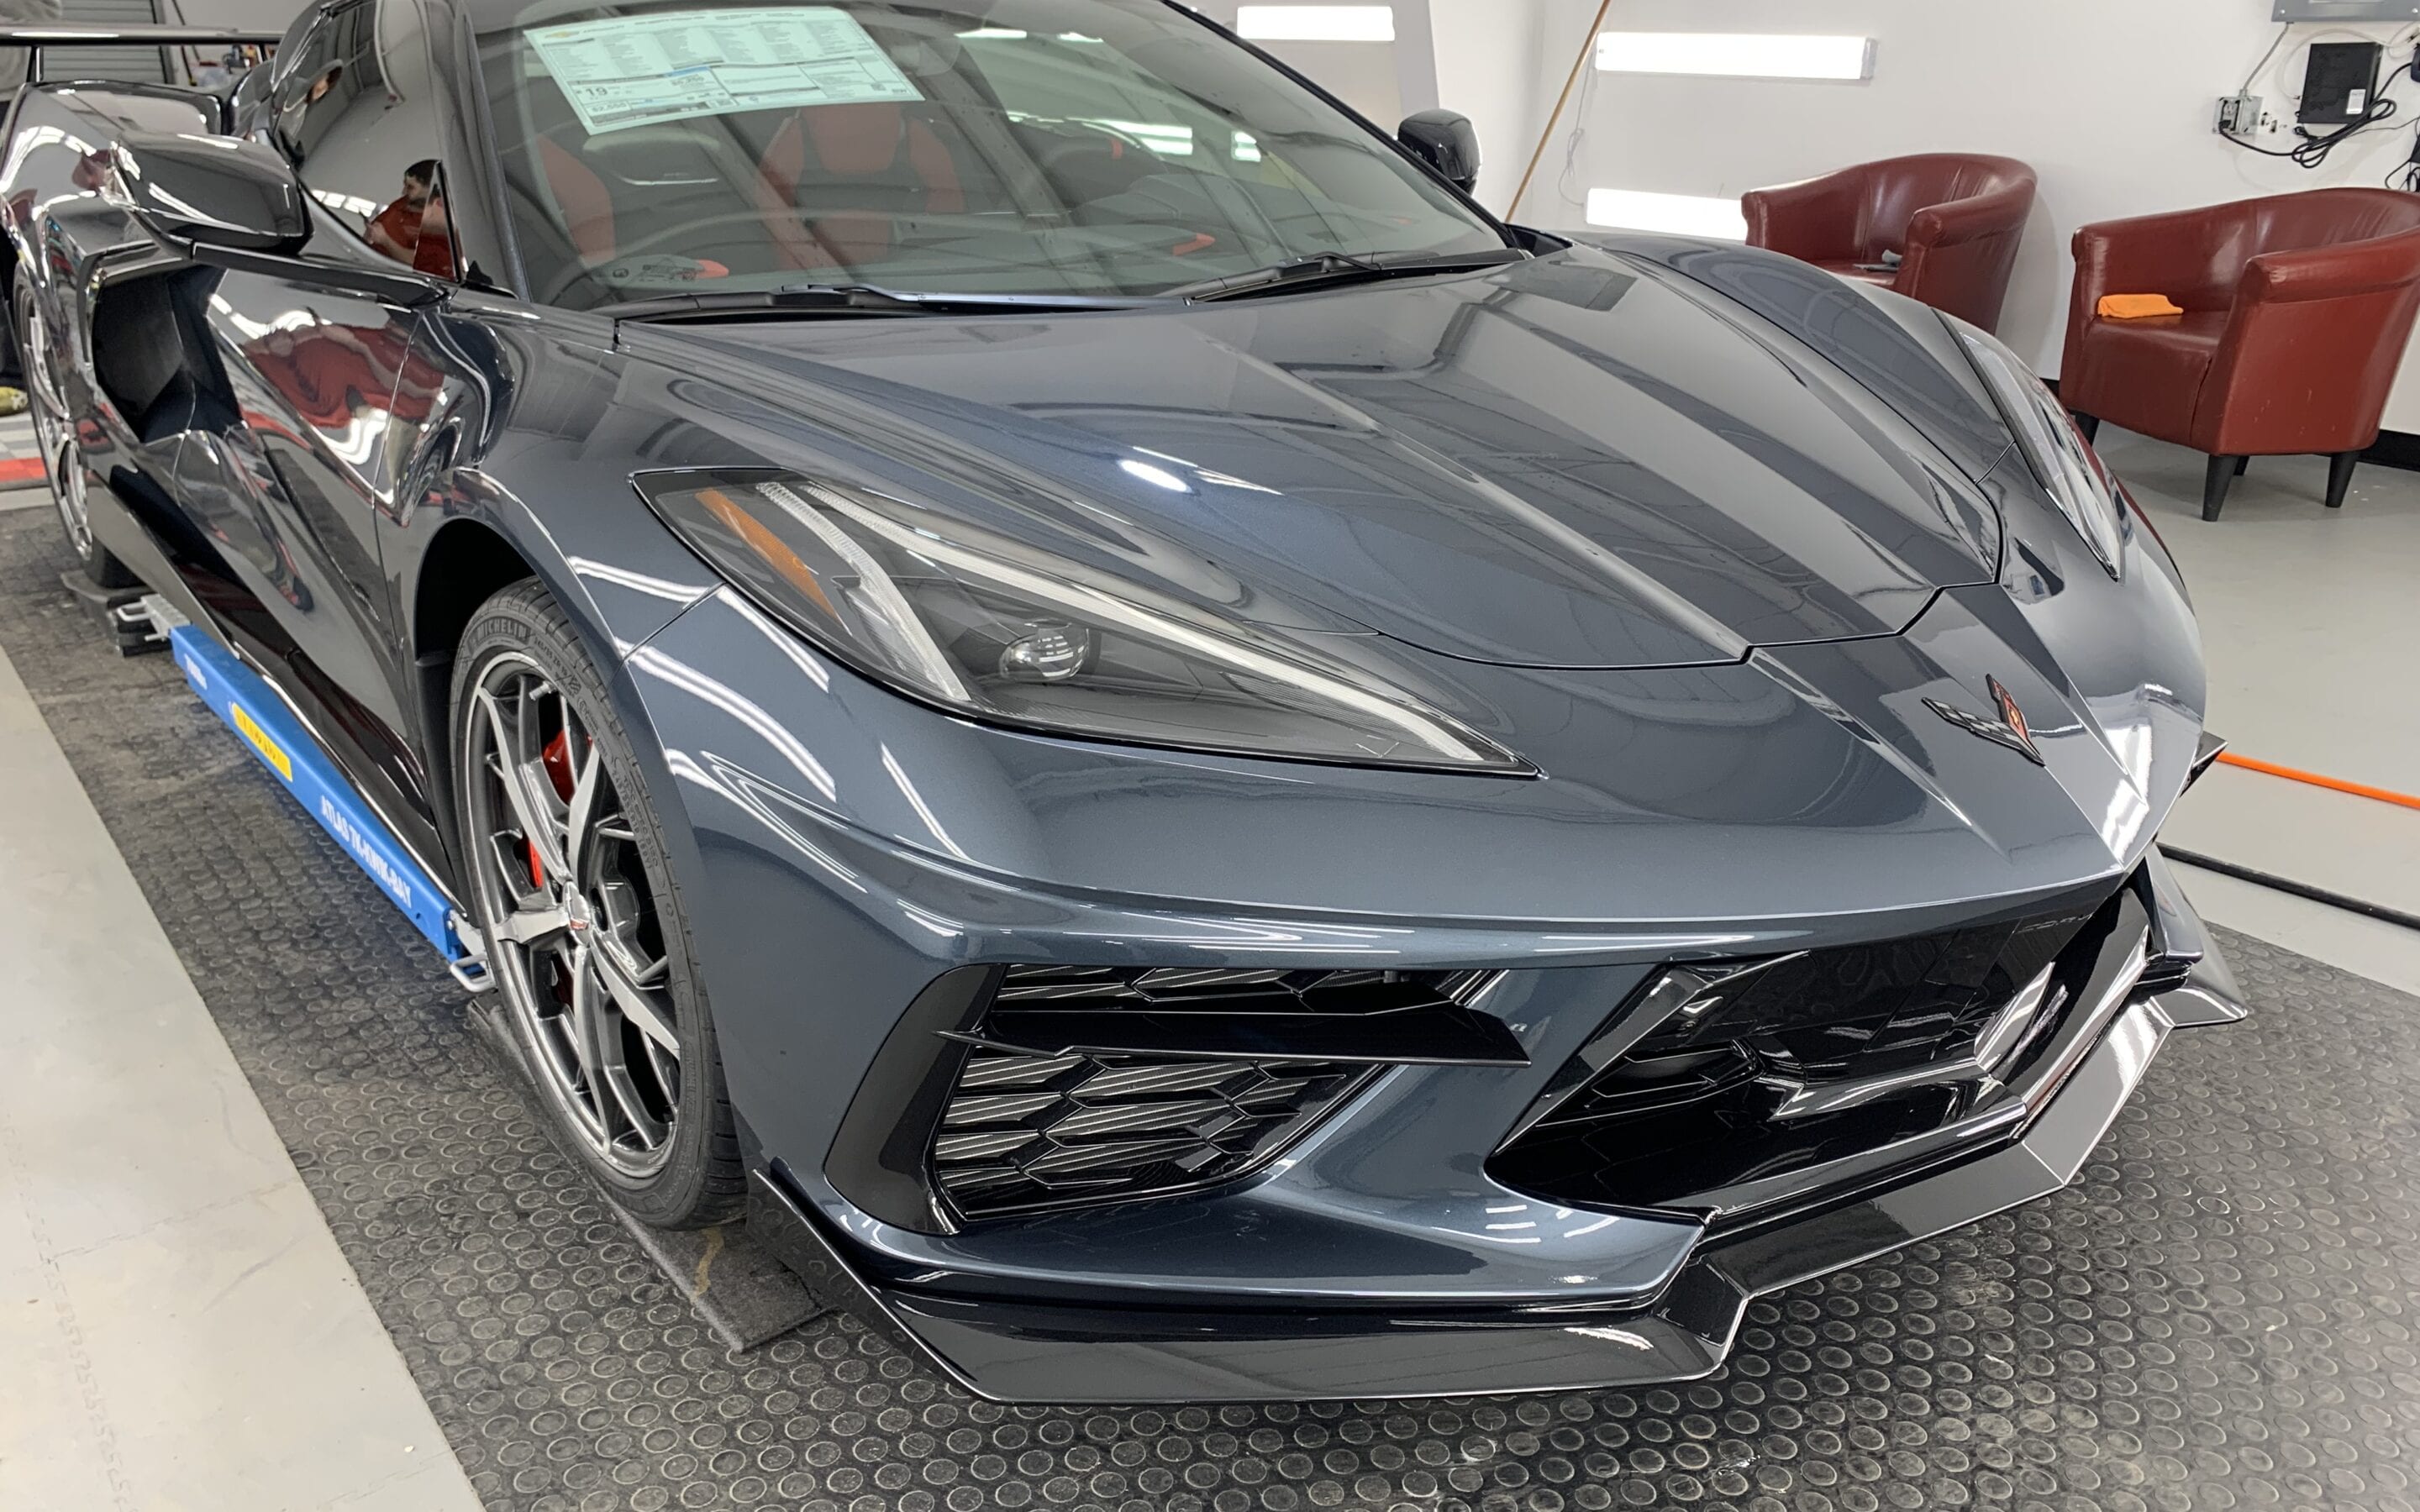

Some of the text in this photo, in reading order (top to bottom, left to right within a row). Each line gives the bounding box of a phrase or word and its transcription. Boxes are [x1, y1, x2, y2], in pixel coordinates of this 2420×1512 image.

[585, 87, 608, 97] 19
[476, 618, 528, 642] MICHELIN
[321, 795, 350, 843] ATLAS
